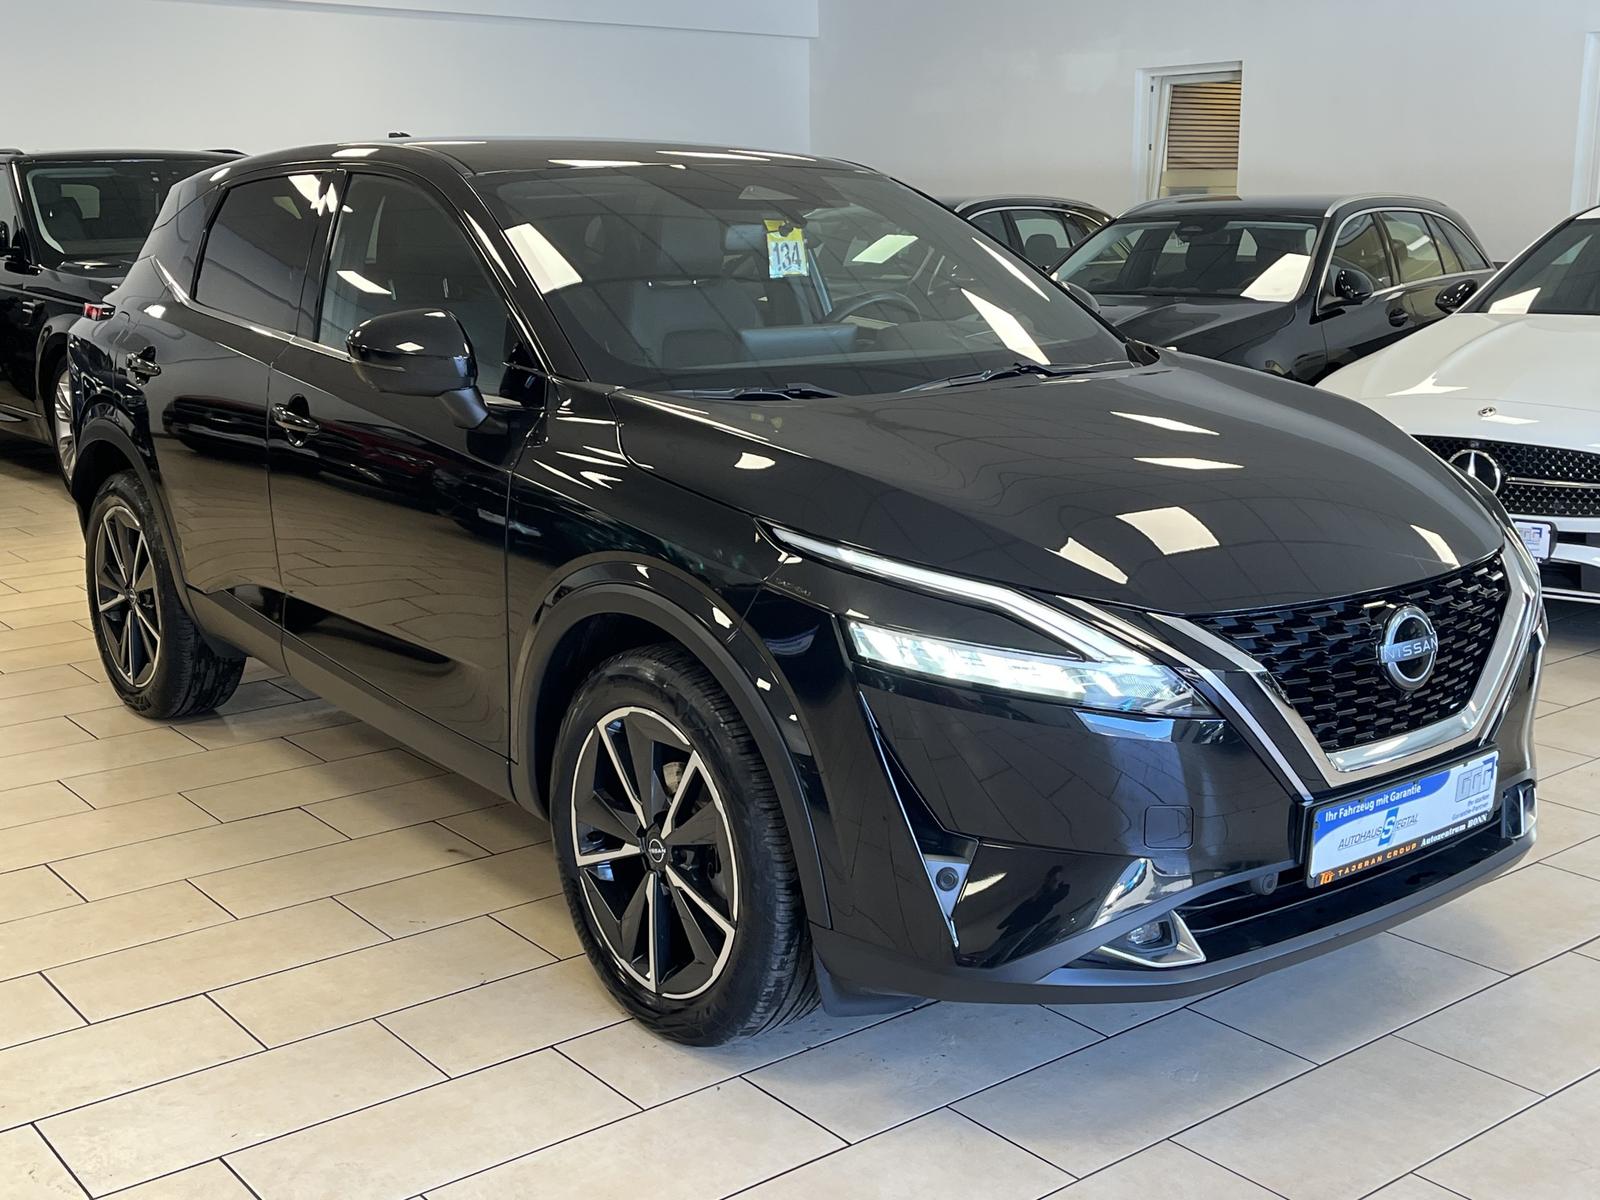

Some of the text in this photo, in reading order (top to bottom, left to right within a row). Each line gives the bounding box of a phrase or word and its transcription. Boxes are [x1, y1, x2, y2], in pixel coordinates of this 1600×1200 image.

[773, 242, 801, 271] 134
[1383, 637, 1438, 660] NISSAN
[1325, 783, 1422, 822] Ihr Fahrzeug mit Garantie
[1338, 826, 1383, 849] AUTOHAUS
[1421, 823, 1467, 847] Autozentrum
[1387, 843, 1417, 859] GROUP
